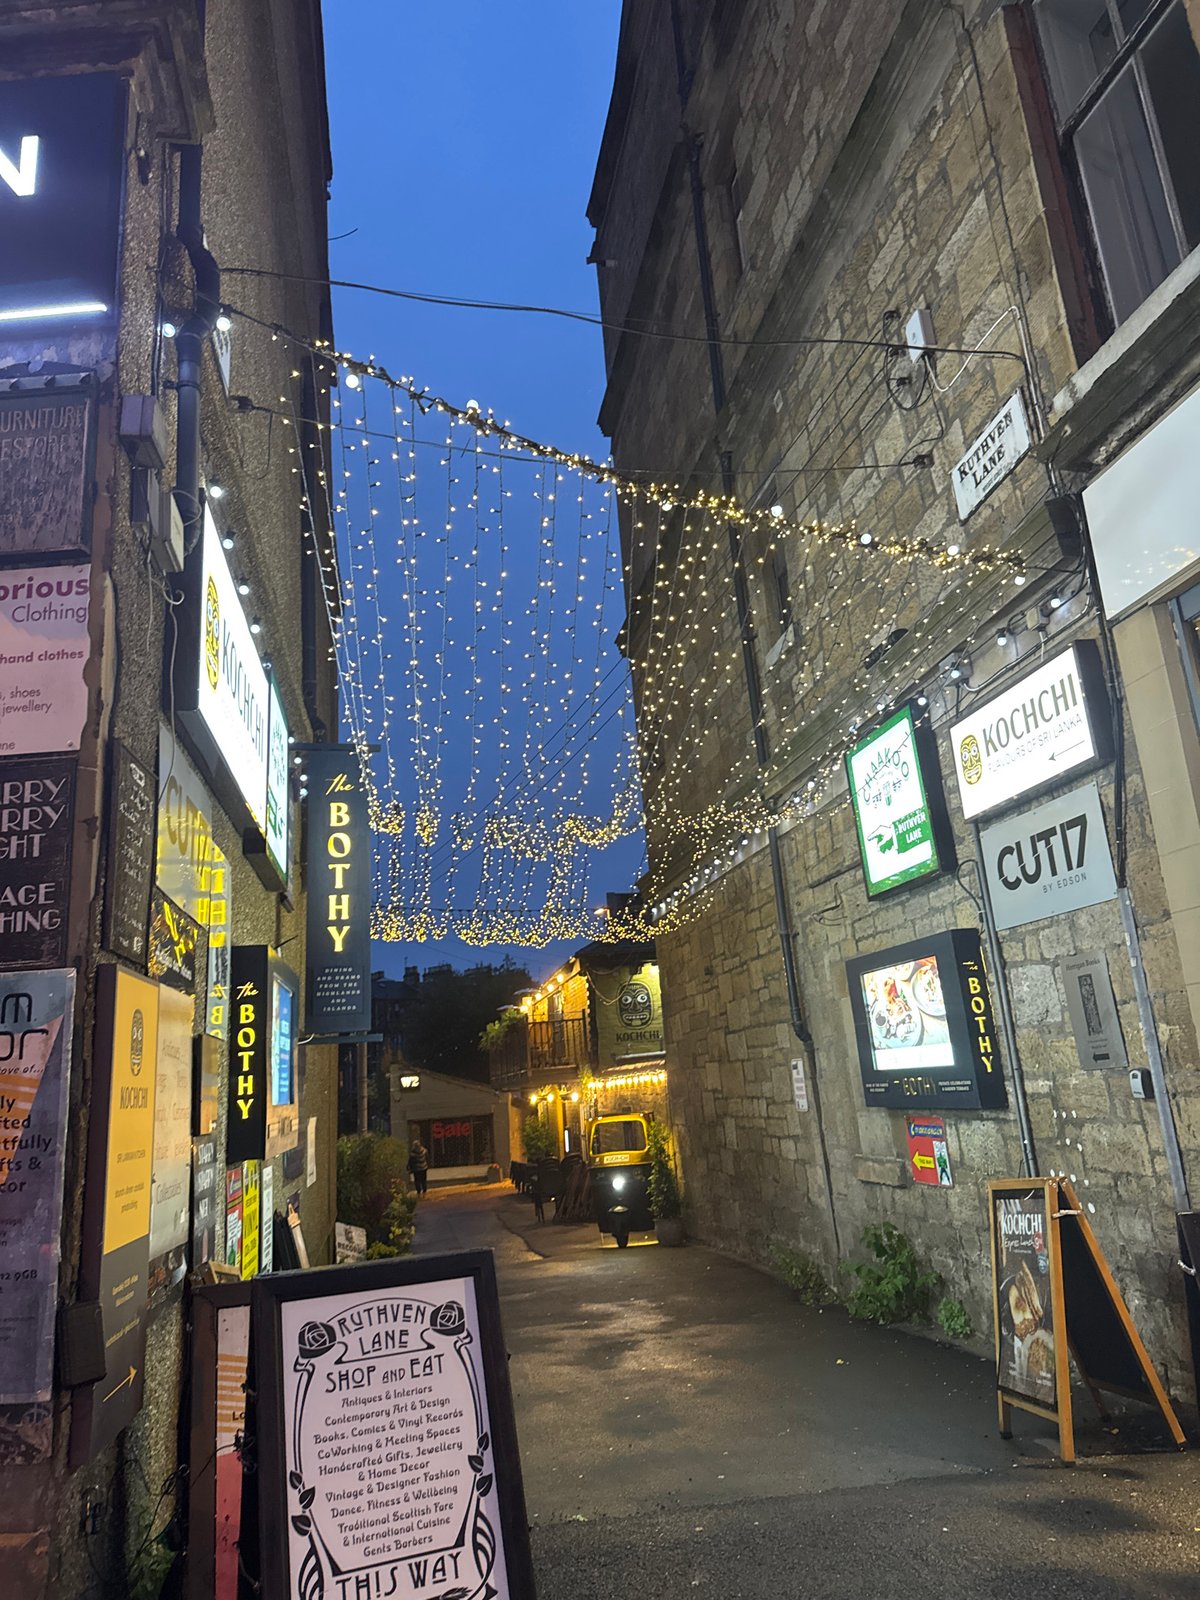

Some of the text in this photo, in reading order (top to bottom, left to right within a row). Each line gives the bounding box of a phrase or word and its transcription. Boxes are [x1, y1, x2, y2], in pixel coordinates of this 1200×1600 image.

[957, 409, 1013, 483] RUTHVEN
[972, 444, 1006, 489] LANE
[11, 602, 87, 624] Clothing
[38, 649, 85, 662] clothes
[10, 686, 42, 700] shoes
[222, 619, 265, 764] KOCHCHI
[2, 702, 53, 717] jewellery
[982, 673, 1078, 757] KOCHCHI
[1038, 729, 1052, 747] SRI
[1054, 713, 1083, 739] LANKA
[898, 812, 926, 833] RUTHVEN
[905, 828, 922, 844] LANE
[997, 812, 1088, 891] CUT17
[327, 802, 351, 952] BOTHY
[1042, 872, 1087, 894] BY EDSON
[616, 1029, 660, 1043] KOCHCHI
[968, 977, 993, 1073] BOTHY
[236, 1004, 256, 1120] BOTHY
[120, 1086, 148, 1110] KOCHCHI
[432, 1121, 471, 1140] Sale
[28, 1156, 42, 1170] &
[1001, 1213, 1043, 1235] KOCHCHI
[337, 1303, 427, 1337] RUTHVEN
[358, 1328, 409, 1356] LANE
[325, 1353, 445, 1393] SHOP AND EAT
[324, 1396, 450, 1427] Contemporary Art & Design
[341, 1384, 433, 1408] Antiques & Interiors
[313, 1408, 464, 1445] Books, Comics & Vinyl Records
[317, 1425, 461, 1460] CoWorking & Meeting Spaces
[318, 1440, 463, 1476] Handcrafted Gifts, Jewellery
[358, 1460, 431, 1482] & Home Decor
[325, 1466, 461, 1503] Vintage & Designer Fashion
[330, 1484, 459, 1519] Dance, Fitness & Wellbeing
[337, 1501, 454, 1535] Traditional Scottish Fare
[342, 1515, 451, 1547] & International Cuisine
[363, 1534, 434, 1558] Gents Barbers
[408, 1551, 462, 1590] WAY
